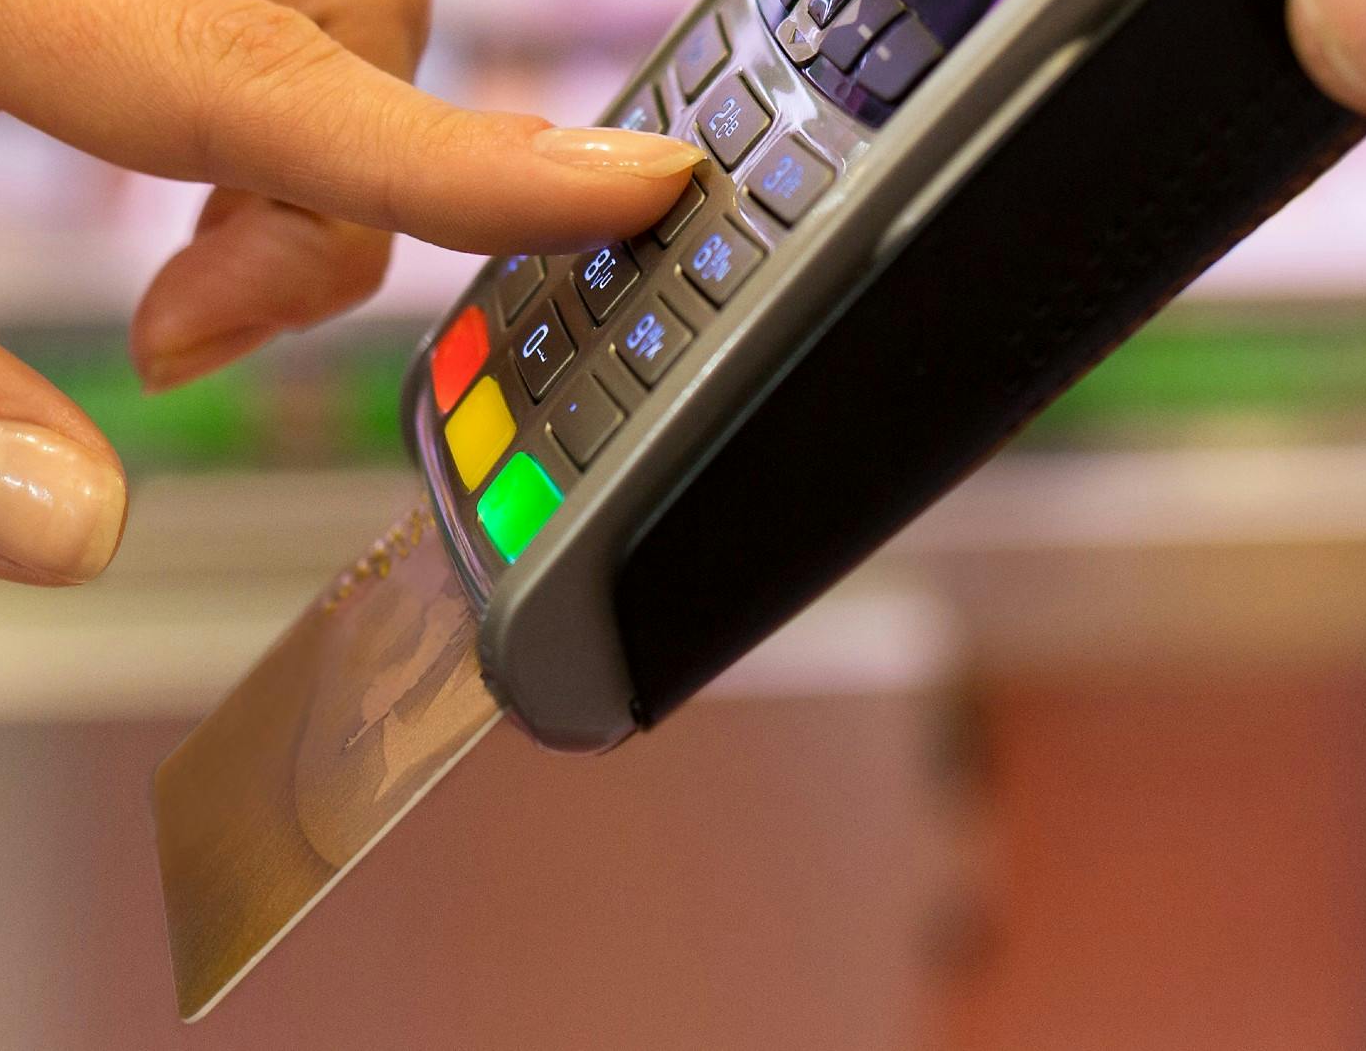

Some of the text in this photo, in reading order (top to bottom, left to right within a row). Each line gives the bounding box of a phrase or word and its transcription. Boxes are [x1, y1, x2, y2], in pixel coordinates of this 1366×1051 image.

[708, 97, 736, 131] 2
[763, 155, 793, 191] 3
[584, 248, 611, 281] 8
[693, 234, 722, 270] 6
[626, 313, 656, 349] 9
